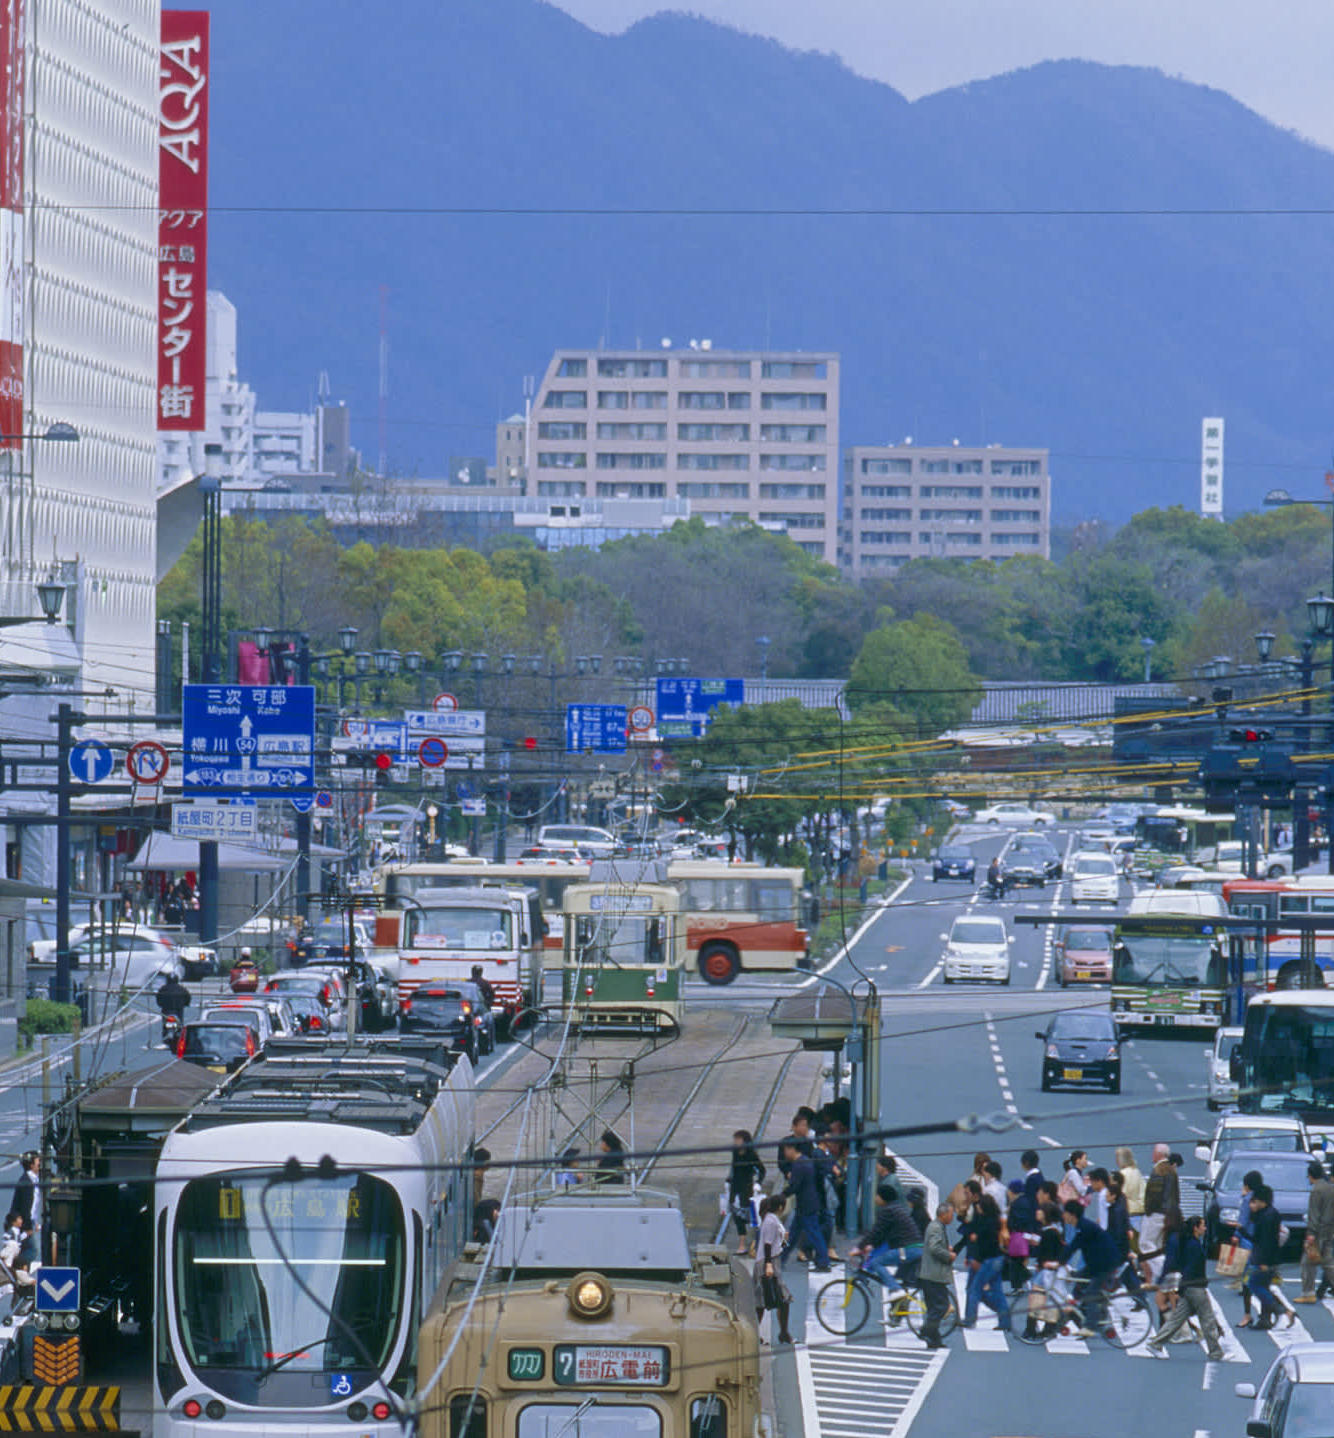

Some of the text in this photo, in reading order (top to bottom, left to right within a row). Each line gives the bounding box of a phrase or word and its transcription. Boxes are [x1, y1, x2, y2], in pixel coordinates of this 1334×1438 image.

[160, 267, 195, 419] センター街
[207, 689, 286, 705] 三次 可部
[208, 705, 241, 716] Miyoshi
[191, 737, 228, 752] 横川
[559, 1353, 573, 1376] 7
[600, 1360, 660, 1380] 広電前
